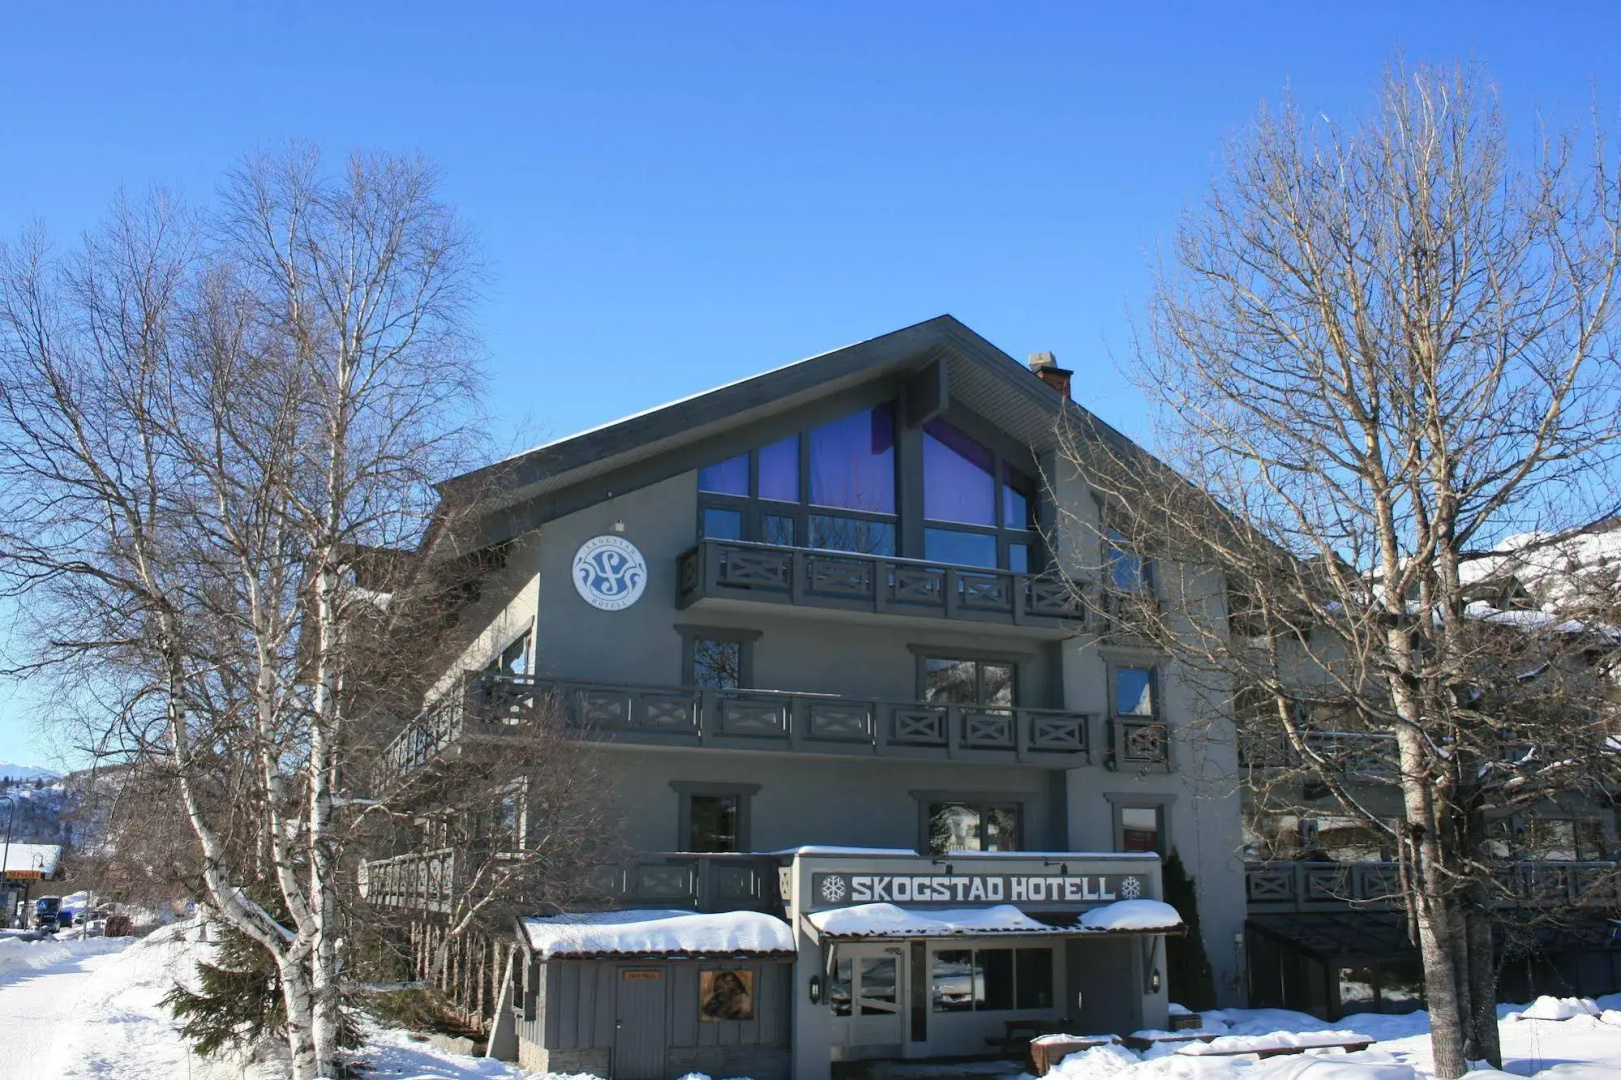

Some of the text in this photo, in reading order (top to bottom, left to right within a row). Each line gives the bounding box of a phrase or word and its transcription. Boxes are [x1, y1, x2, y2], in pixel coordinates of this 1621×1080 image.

[8, 870, 40, 879] Shell
[851, 876, 1116, 901] SKOGSTAD HOTELL
